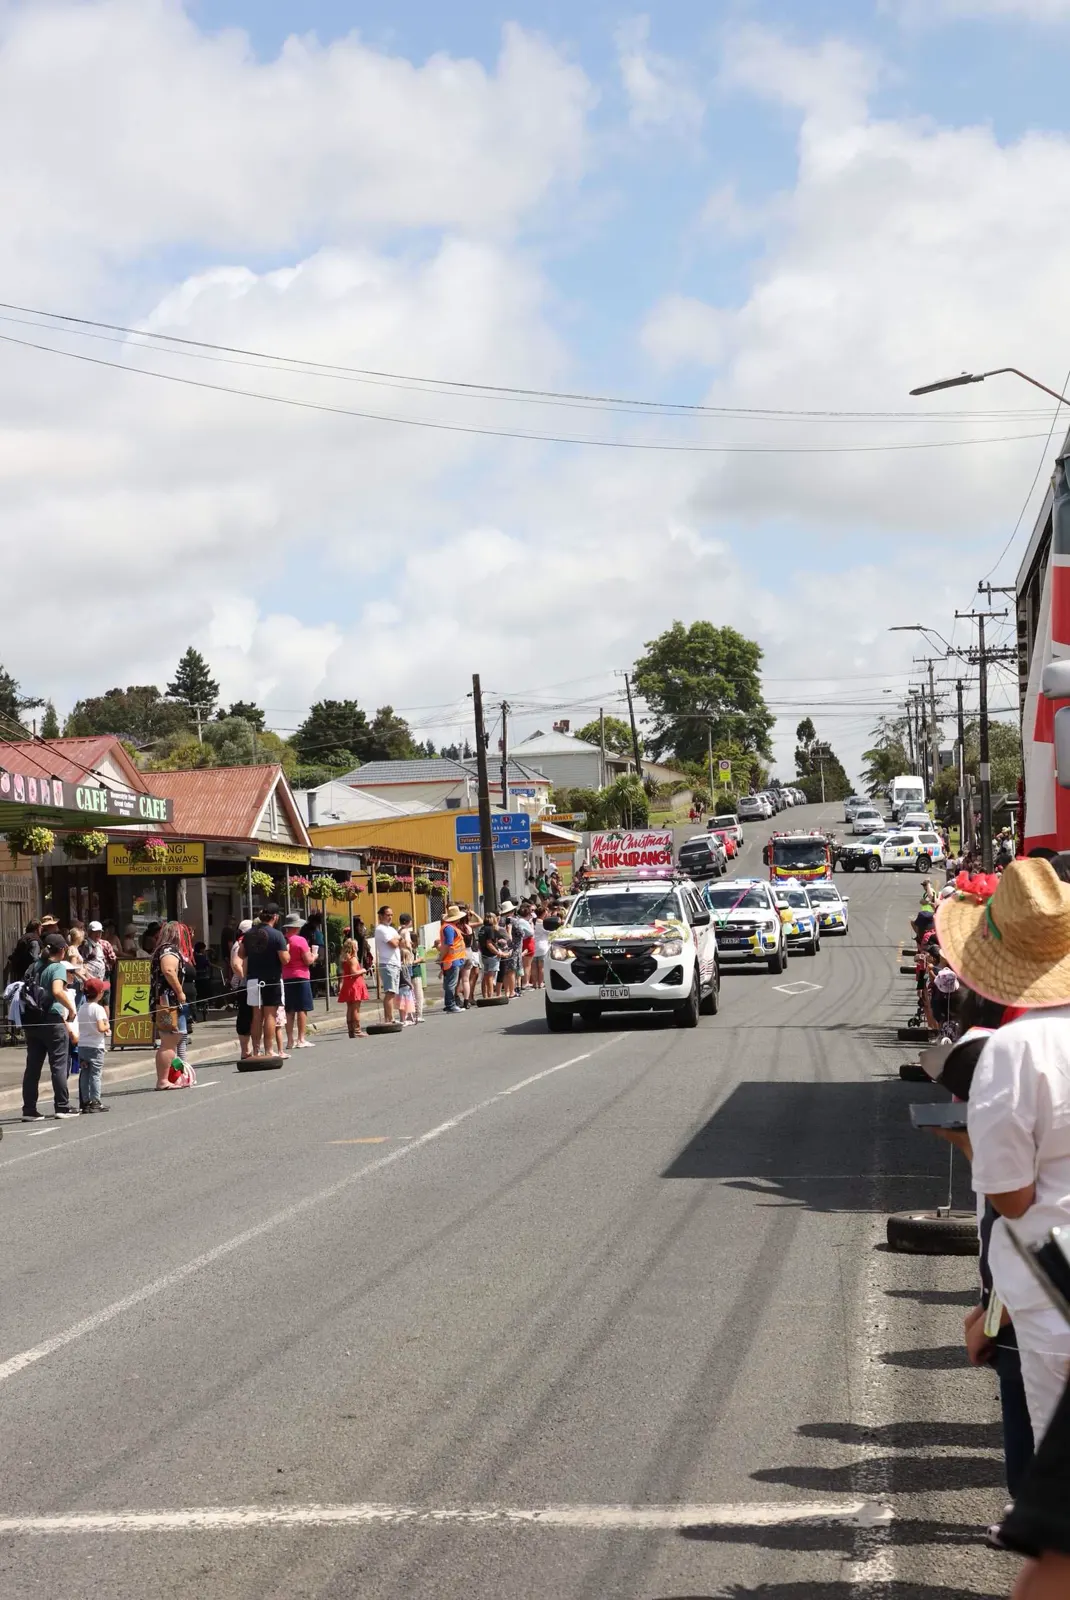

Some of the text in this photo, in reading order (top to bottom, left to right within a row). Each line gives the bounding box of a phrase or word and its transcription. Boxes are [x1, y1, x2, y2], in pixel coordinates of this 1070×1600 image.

[76, 787, 107, 812] CAFÉ
[139, 796, 167, 820] CAFÉ
[592, 833, 670, 853] Merry Christmas
[598, 850, 671, 868] HIKURANGI
[118, 962, 151, 972] MINER
[116, 1021, 151, 1039] CAFE
